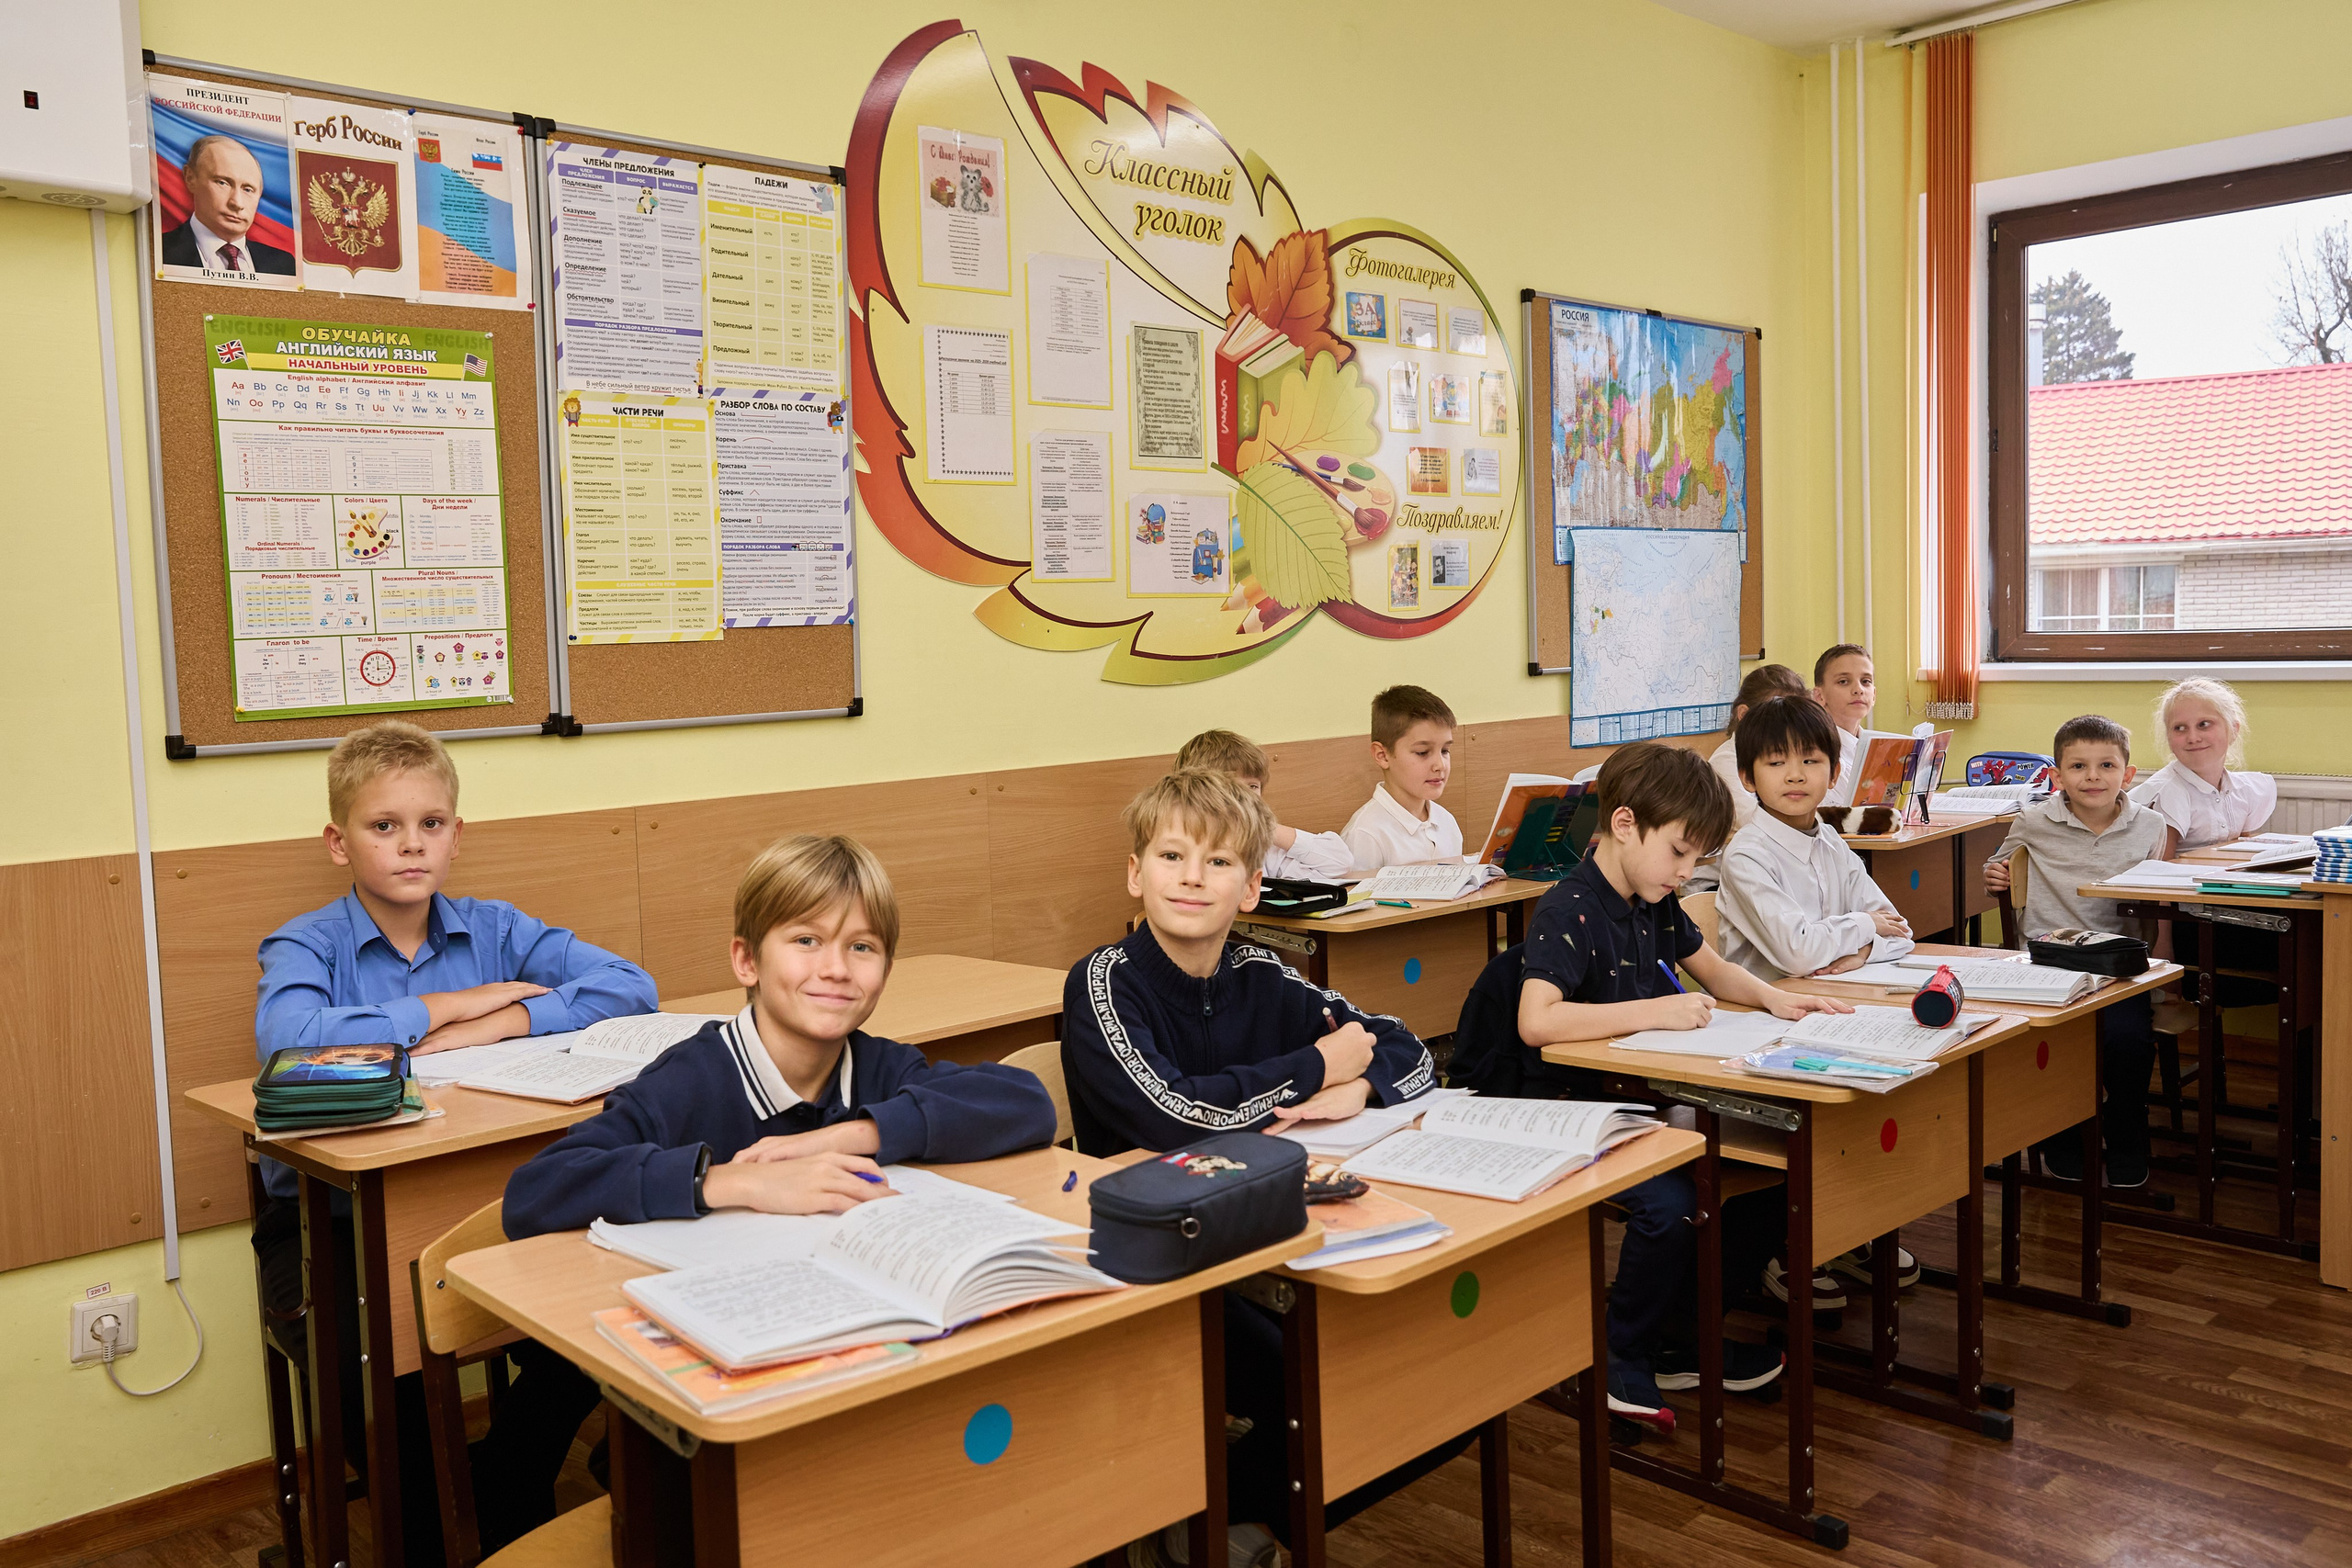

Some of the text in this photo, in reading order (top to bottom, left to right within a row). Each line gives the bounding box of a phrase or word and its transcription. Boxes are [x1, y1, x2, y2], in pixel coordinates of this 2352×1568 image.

[187, 88, 250, 105] ПРЕЗИДЕНТ
[154, 97, 282, 122] РОССИЙСКОЙ ФЕДЕРАЦИИ
[294, 115, 402, 151] Герб России
[931, 144, 935, 158] С
[582, 158, 674, 177] ЧЛЕНЫ ПРЕДЛОЖЕНИЯ
[1084, 140, 1233, 200] Классный
[568, 170, 605, 180] ПРЕДЛОЖЕНИЯ
[561, 178, 603, 190] Подлежащее
[754, 177, 788, 189] ПАДЕЖИ
[562, 207, 596, 216] Сказуемое
[710, 223, 753, 234] Именительный
[1135, 204, 1222, 242] уголок
[564, 235, 603, 245] Дополнение
[711, 247, 749, 257] Родительный
[565, 262, 606, 272] Определение
[1345, 248, 1455, 289] Фотогалерея
[202, 269, 234, 278] Путин
[712, 272, 743, 280] Дательный
[566, 293, 614, 303] Обстоятельство
[712, 297, 750, 307] Винительный
[1562, 309, 1589, 321] РОССИЯ
[210, 320, 286, 336] ENGLISH
[641, 326, 676, 334] ПРЕДЛОЖЕНИЯ
[713, 321, 752, 331] Творительный
[301, 327, 412, 345] ОБУЧАЙКА
[424, 333, 489, 350] ENGLISH
[276, 341, 437, 362] АНГЛИЙСКИЙ ЯЗЫК
[713, 345, 750, 355] Предложный
[288, 359, 427, 374] НАЧАЛЬНЫЙ УРОВЕНЬ
[357, 388, 369, 397] Gg
[413, 390, 419, 399] Jj
[273, 400, 285, 410] Pp
[294, 401, 307, 410] Qq
[456, 408, 467, 416] Yy
[613, 407, 663, 417] ЧАСТИ РЕЧИ
[720, 400, 751, 409] РАЗБОР
[752, 402, 779, 411] СЛОВА
[795, 404, 825, 413] СОСТАВУ
[1396, 503, 1503, 534] Поздравляем!
[1092, 956, 1108, 1001] EMPORIO
[1096, 1001, 1124, 1041] ARMANI
